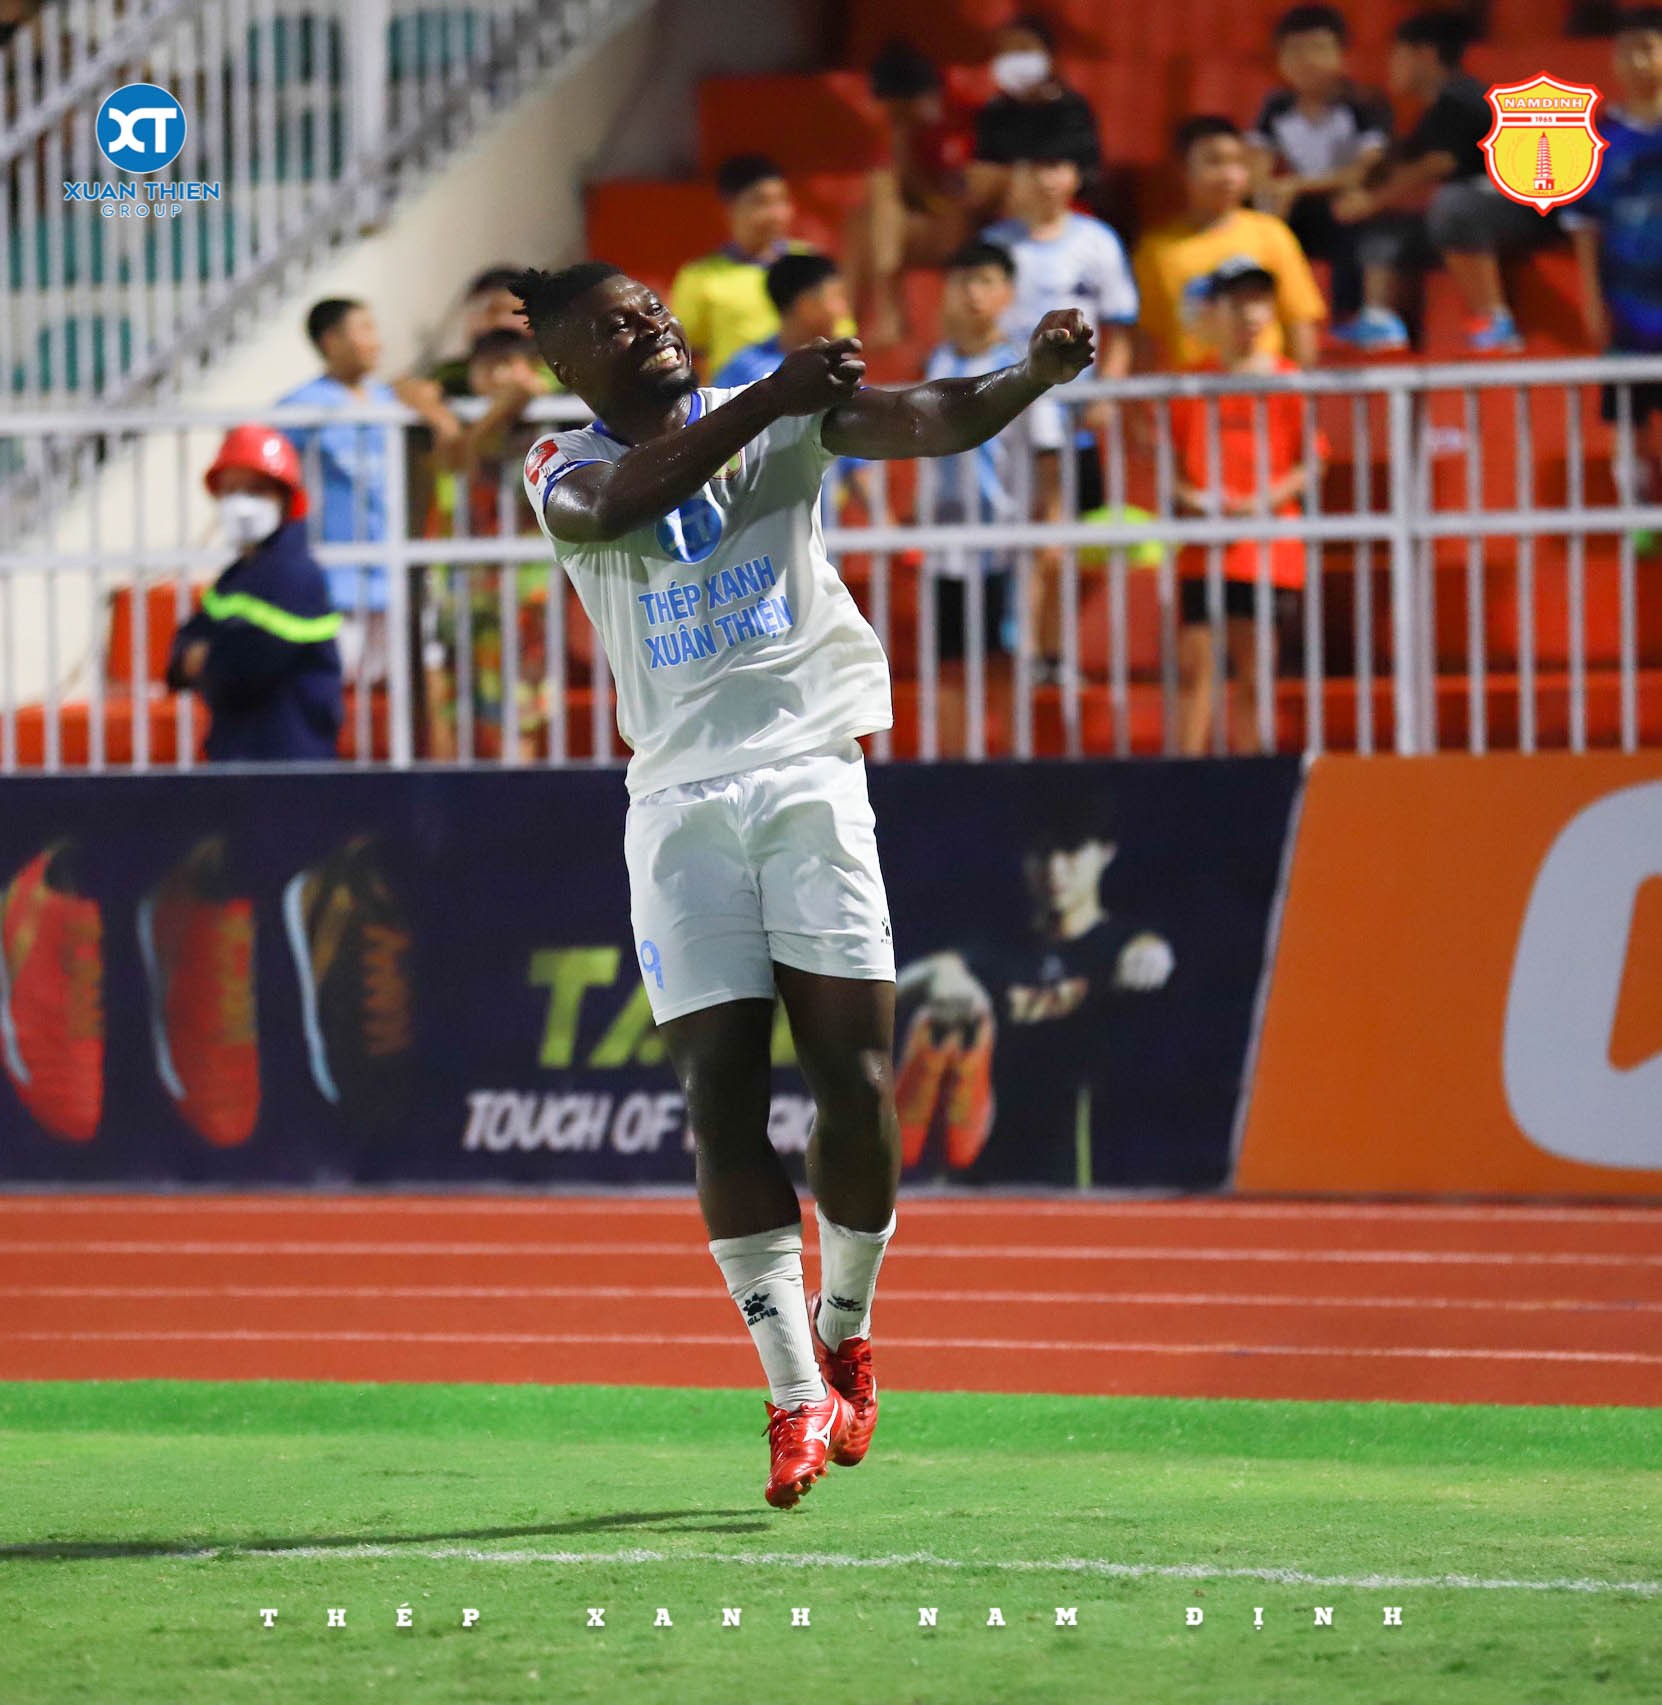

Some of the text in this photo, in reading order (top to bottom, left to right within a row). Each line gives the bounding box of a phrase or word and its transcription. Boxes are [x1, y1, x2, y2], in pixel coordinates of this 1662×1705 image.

[638, 555, 777, 625] THÉP XANH
[644, 595, 794, 669] XUÂN THIỆN
[640, 940, 664, 990] 9
[463, 1091, 613, 1151] TOUCH
[611, 1091, 686, 1153] OF
